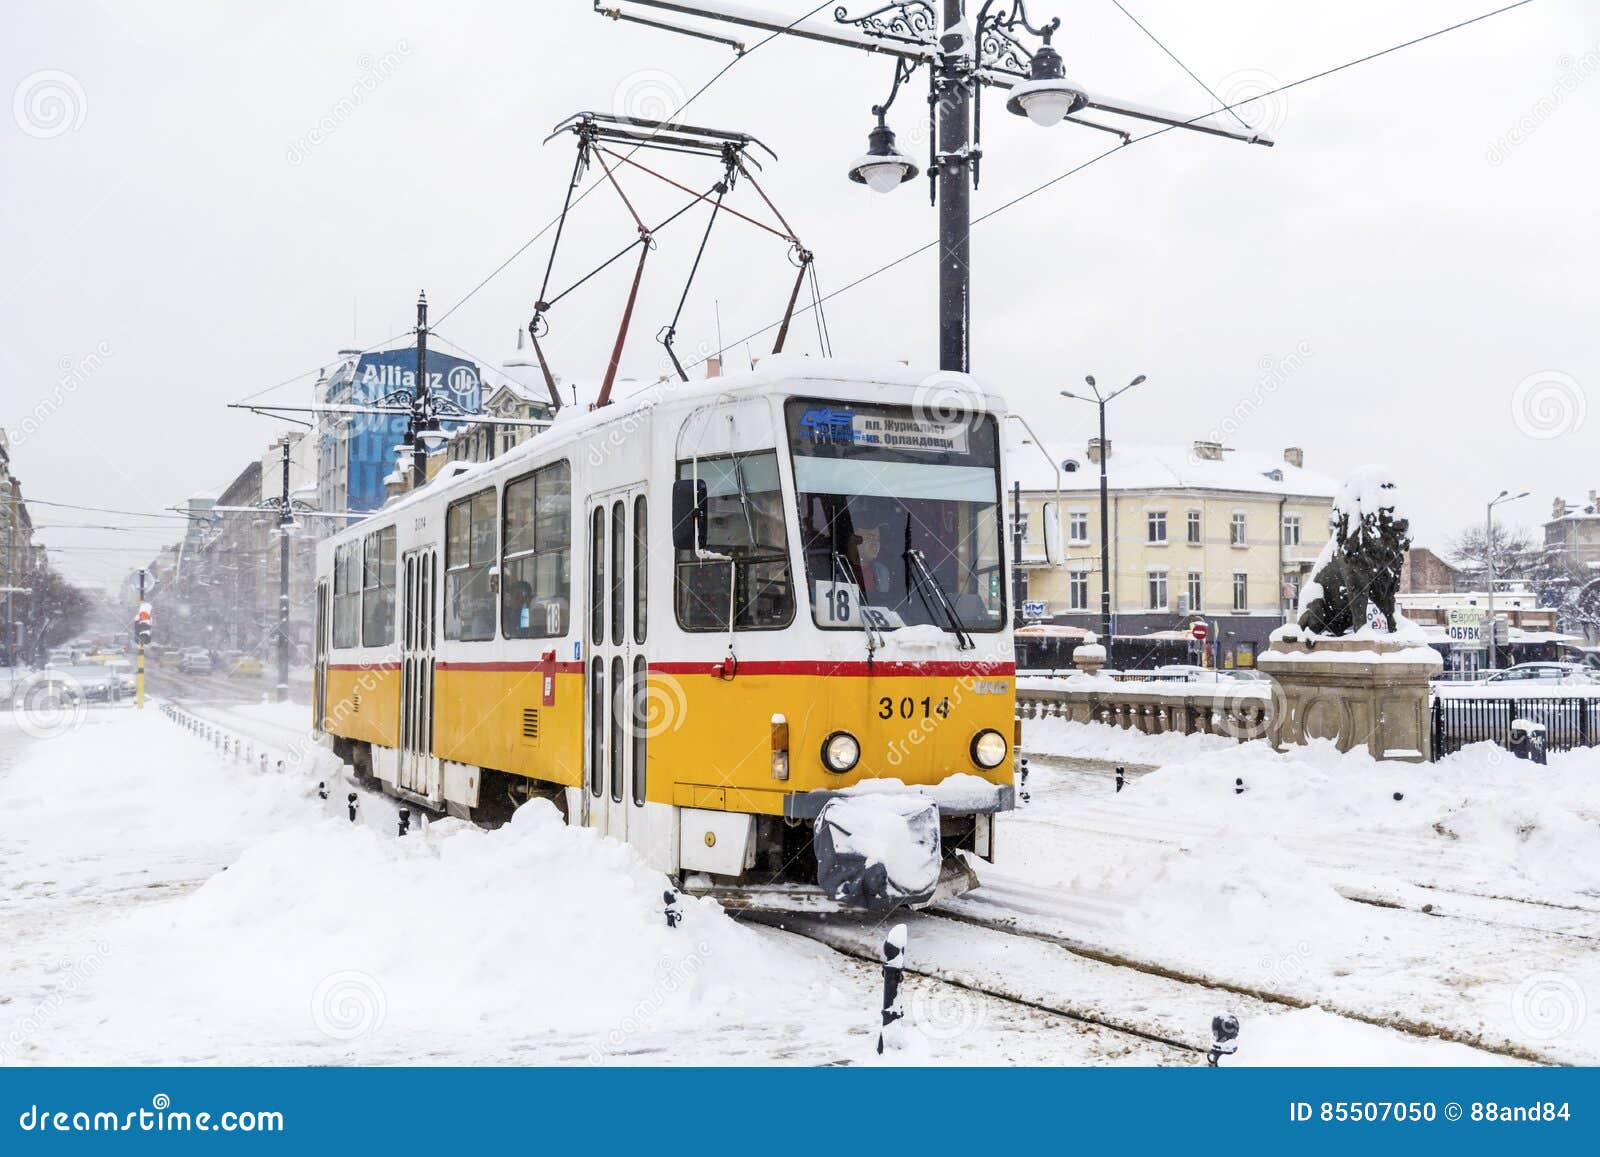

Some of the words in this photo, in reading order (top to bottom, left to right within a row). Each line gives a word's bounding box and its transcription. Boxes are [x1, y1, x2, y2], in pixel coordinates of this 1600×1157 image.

[826, 589, 850, 622] 18
[548, 605, 560, 633] 18
[1450, 626, 1480, 640] ОБУВК
[878, 696, 949, 720] 3014
